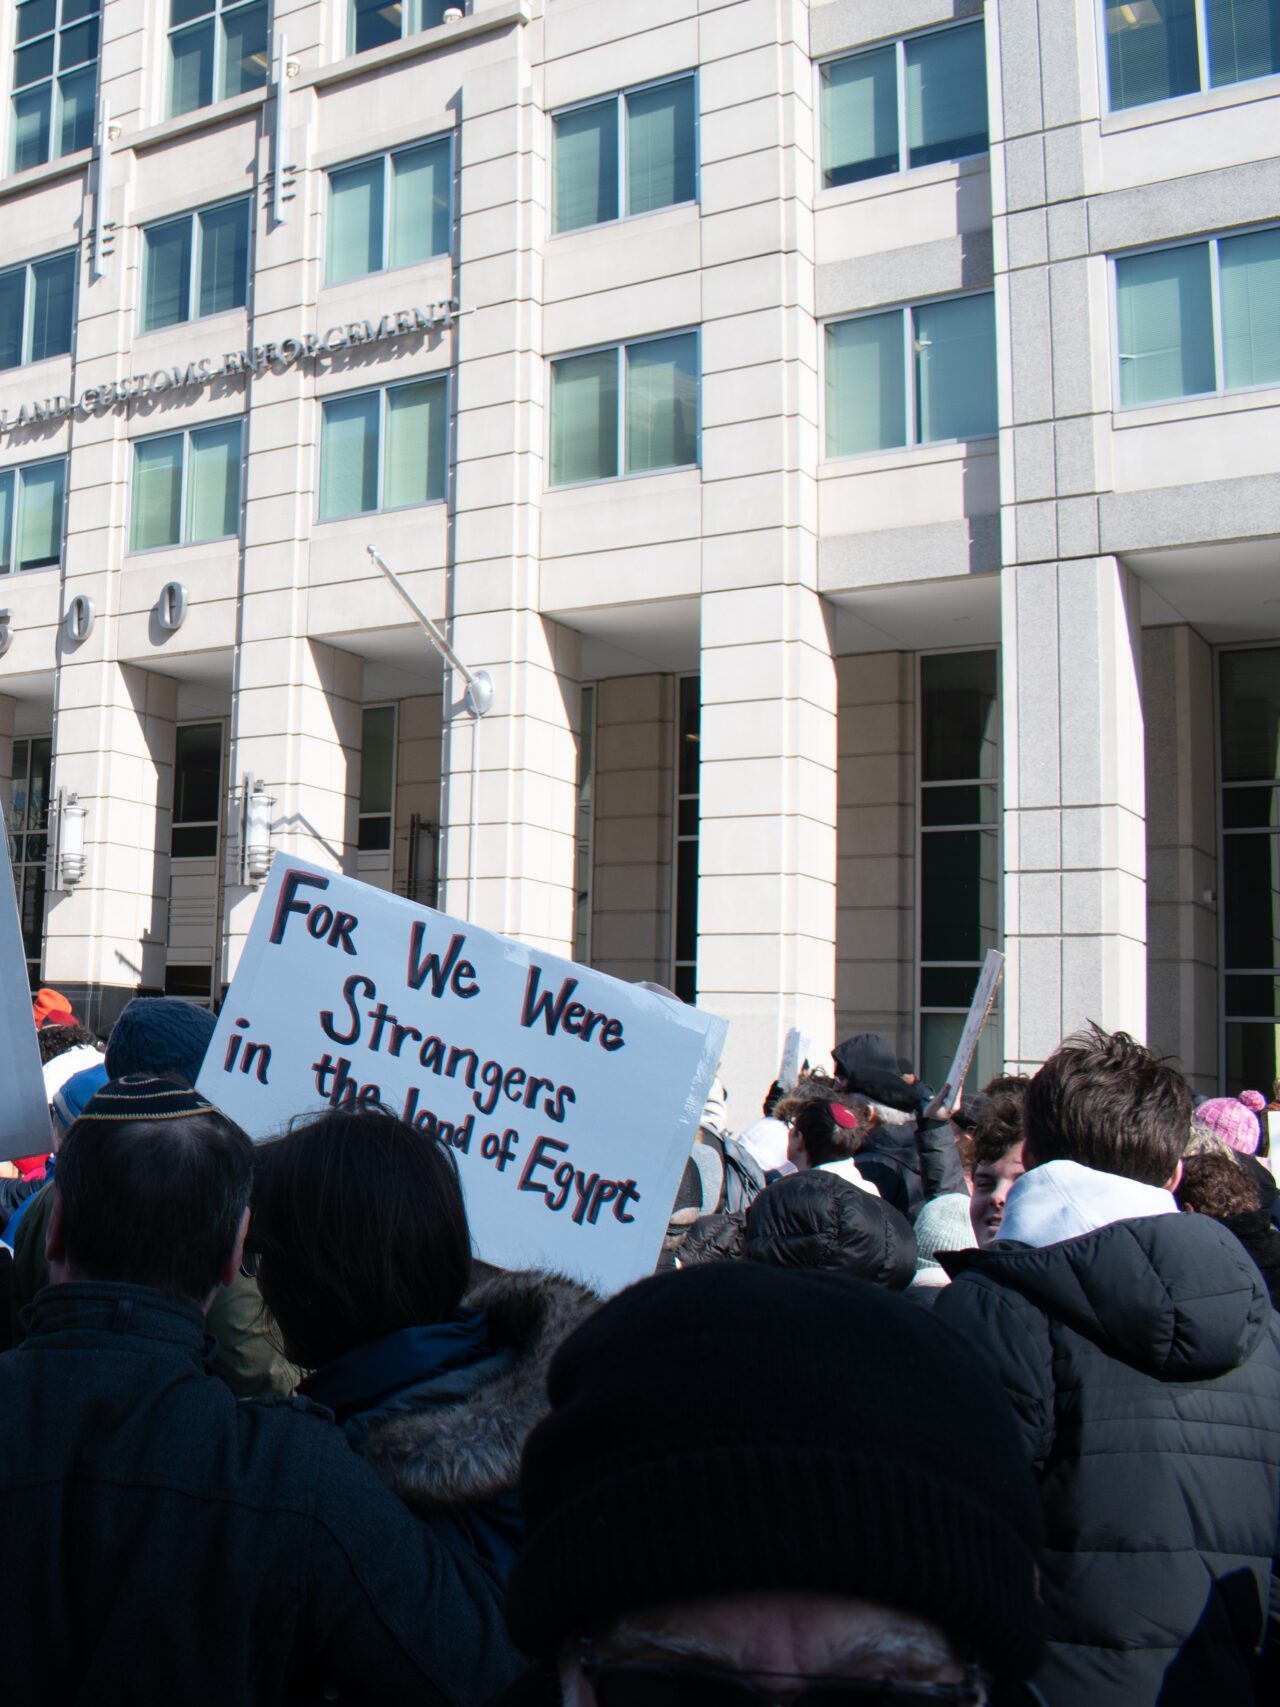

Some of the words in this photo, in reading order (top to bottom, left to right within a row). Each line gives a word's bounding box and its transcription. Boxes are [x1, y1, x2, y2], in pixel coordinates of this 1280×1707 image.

[15, 394, 70, 426] AND
[80, 357, 212, 414] CUSTOMS
[220, 296, 460, 377] ENFORCEMENT
[320, 974, 577, 1123] Strangers
[407, 921, 480, 998] We
[520, 965, 626, 1051] Were
[224, 1018, 272, 1085] in
[311, 1053, 381, 1111] the
[480, 1128, 519, 1173] of
[517, 1135, 641, 1225] Egypt
